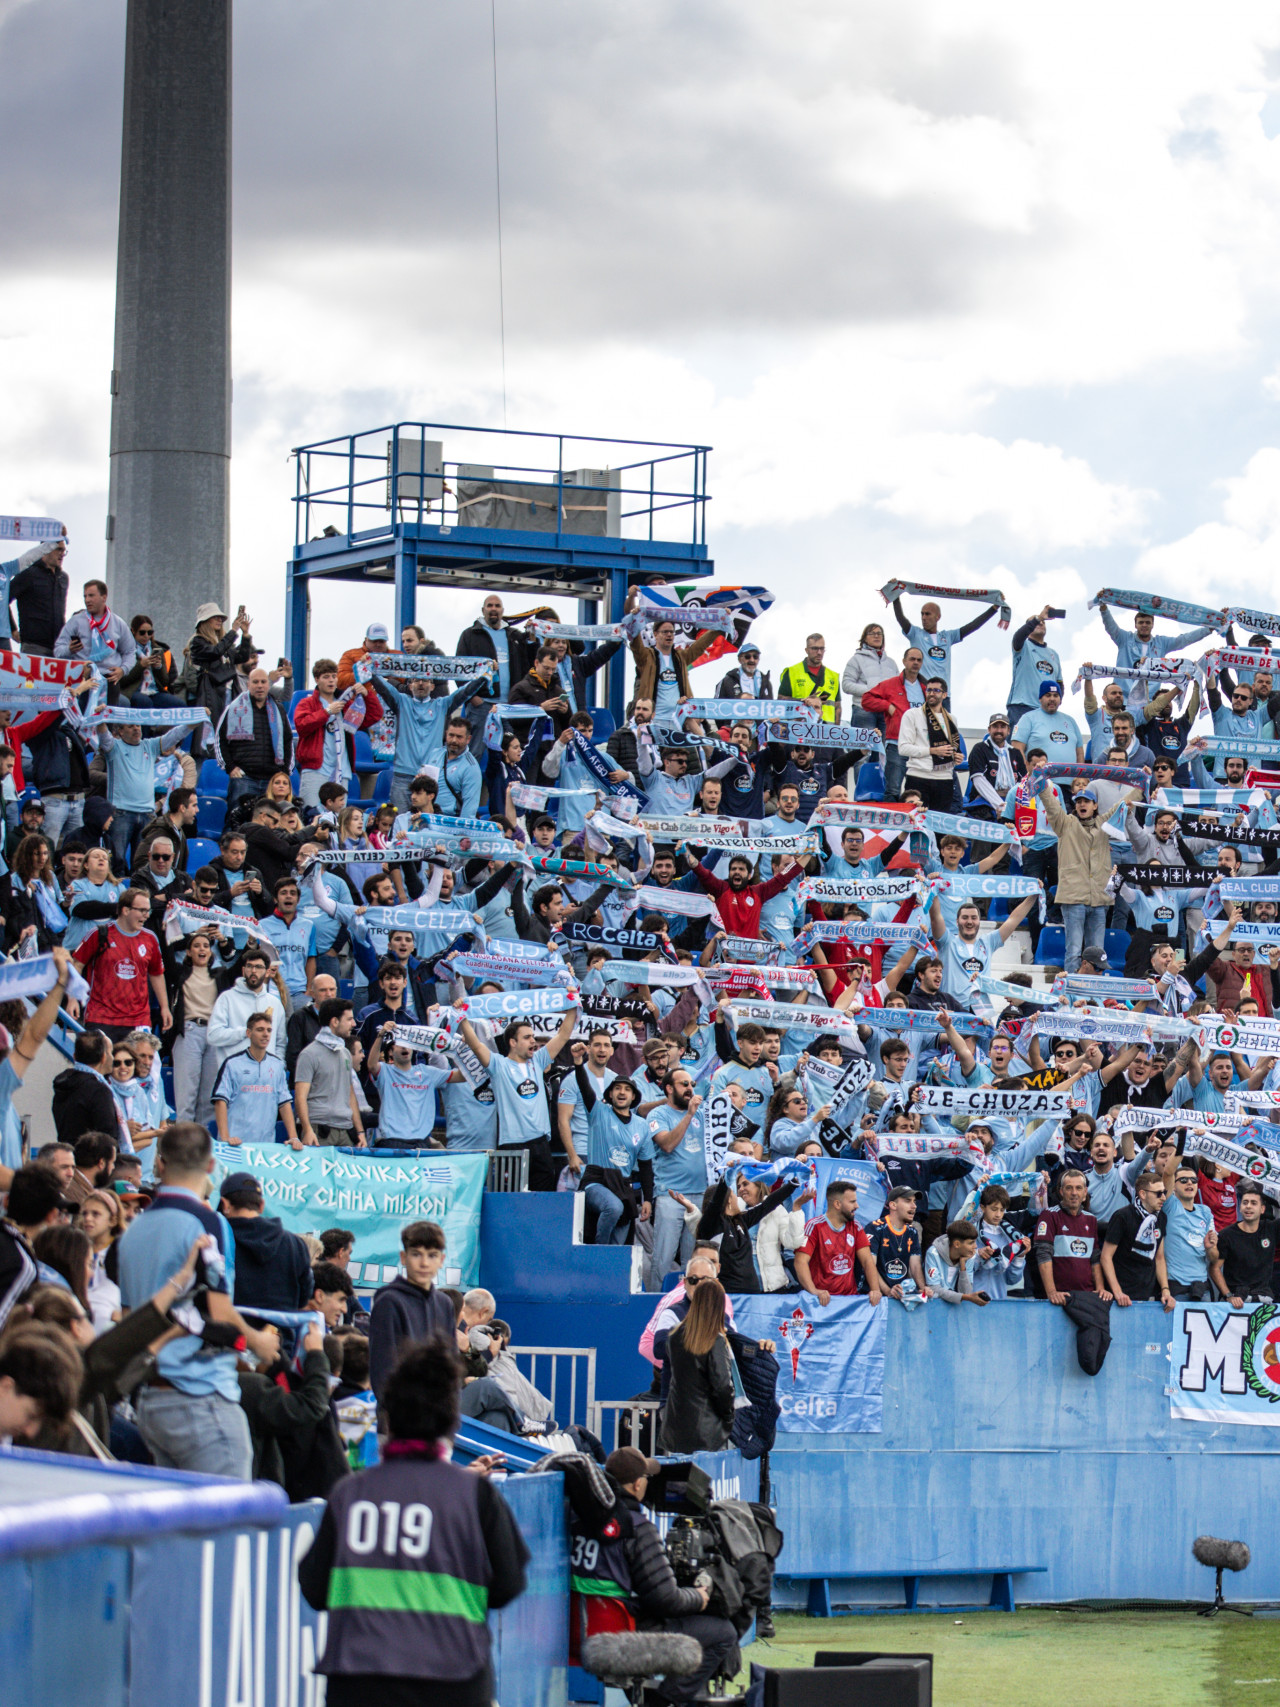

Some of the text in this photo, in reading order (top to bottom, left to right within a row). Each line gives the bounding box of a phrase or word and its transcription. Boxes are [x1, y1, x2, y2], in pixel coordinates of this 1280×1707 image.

[1118, 589, 1203, 620] IAGO ASPAS
[384, 658, 478, 674] siareiros.net
[1222, 652, 1273, 667] CELTA DE
[791, 723, 850, 741] EXILES
[459, 818, 497, 831] CELTA
[836, 808, 899, 825] CELTA
[660, 821, 731, 836] Club Vigo
[472, 840, 521, 854] ASPAS
[702, 836, 801, 852] siareiros.net
[815, 880, 910, 898] siareiros.net
[1221, 882, 1248, 892] REAL
[1252, 880, 1279, 892] CLUB
[380, 909, 472, 929] RC CELTA
[848, 925, 921, 939] CLUB CELTA
[1232, 923, 1260, 936] CELTA
[274, 945, 305, 953] CITROËN
[465, 960, 497, 971] Cuadrilla
[521, 960, 555, 969] CELTISTA
[769, 969, 816, 985] DE VIGO
[751, 1008, 828, 1027] Club Vigo
[874, 1009, 964, 1028] R.C. CELTA
[1186, 1134, 1247, 1168] MOVIDA
[244, 1146, 312, 1173] TASOS
[383, 1192, 447, 1216] MISION
[781, 1393, 838, 1419] Celta
[346, 1500, 433, 1559] 019
